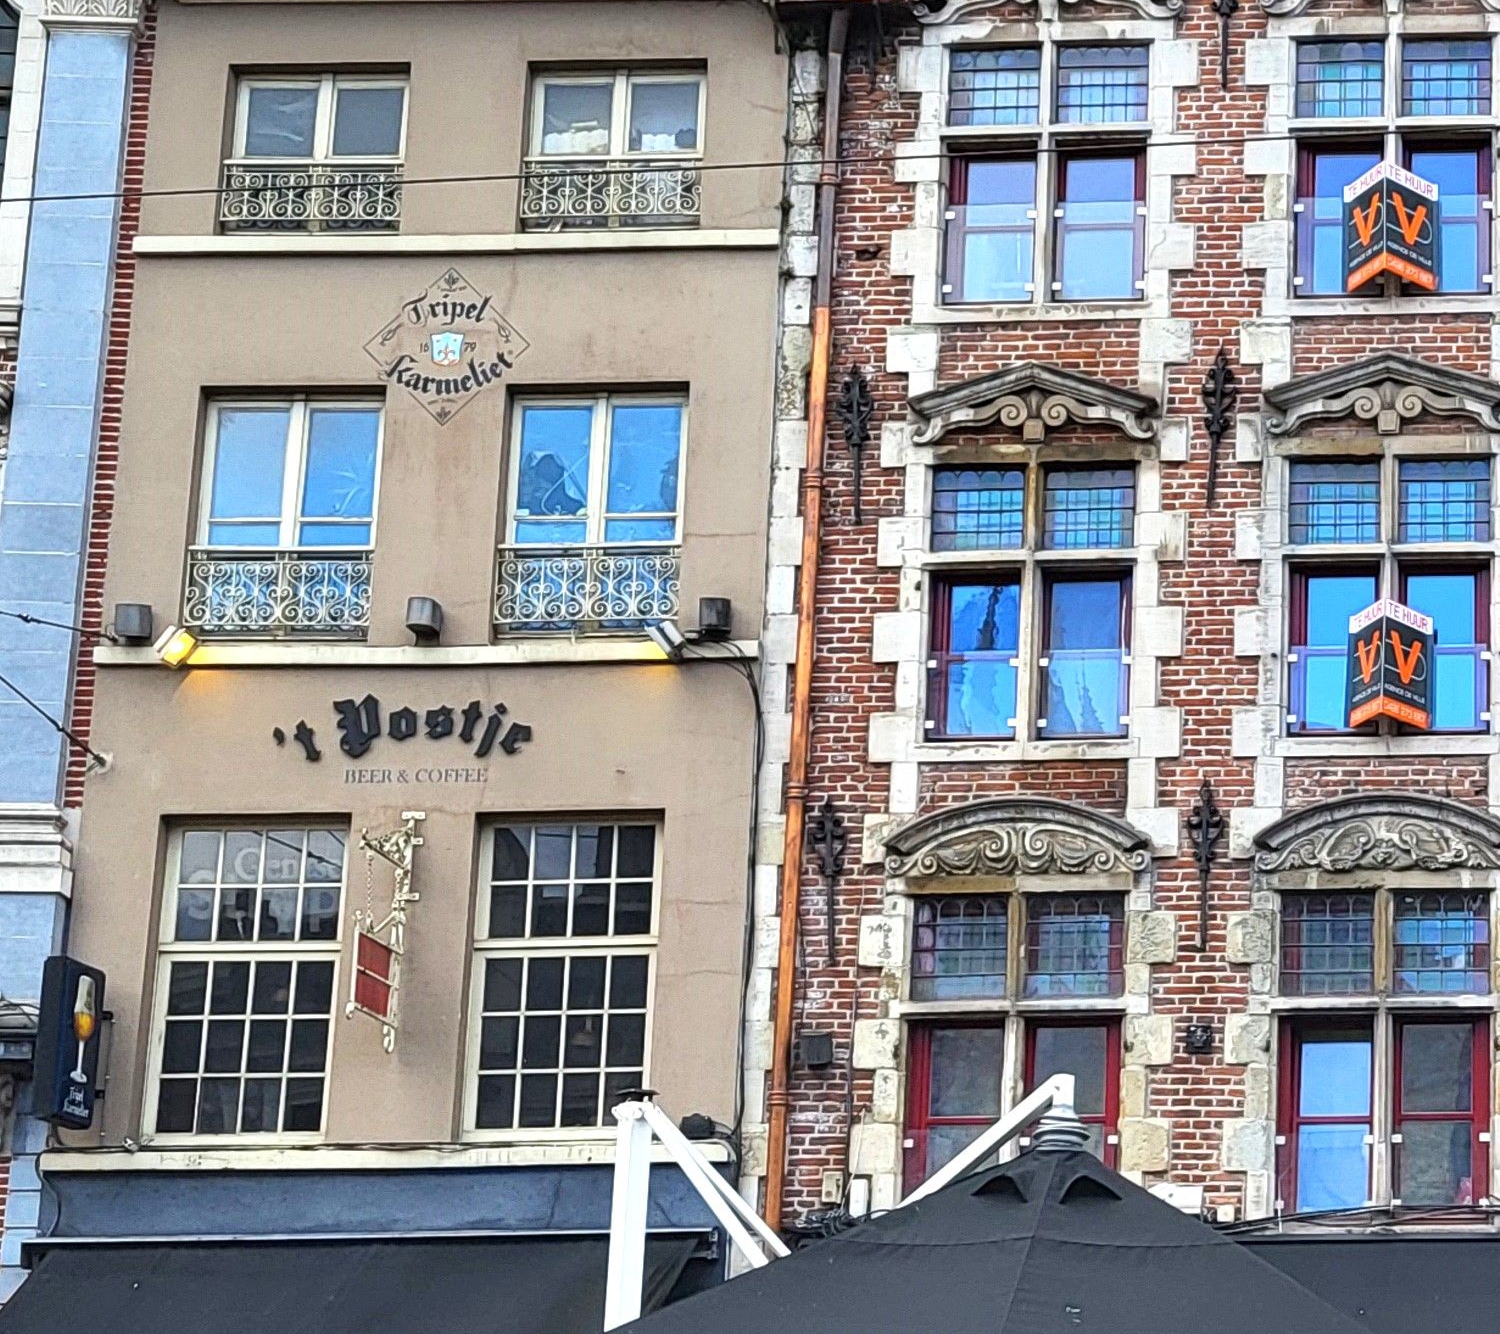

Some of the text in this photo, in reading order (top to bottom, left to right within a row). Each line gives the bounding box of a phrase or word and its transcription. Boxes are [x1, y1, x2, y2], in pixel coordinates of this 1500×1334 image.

[1388, 165, 1434, 198] TE HUUR
[402, 288, 492, 327] Tripel
[378, 350, 513, 396] Karmeliet
[1388, 603, 1429, 629] TE HUUR
[333, 694, 533, 759] Postje
[344, 768, 489, 784] BEER & COFFEE
